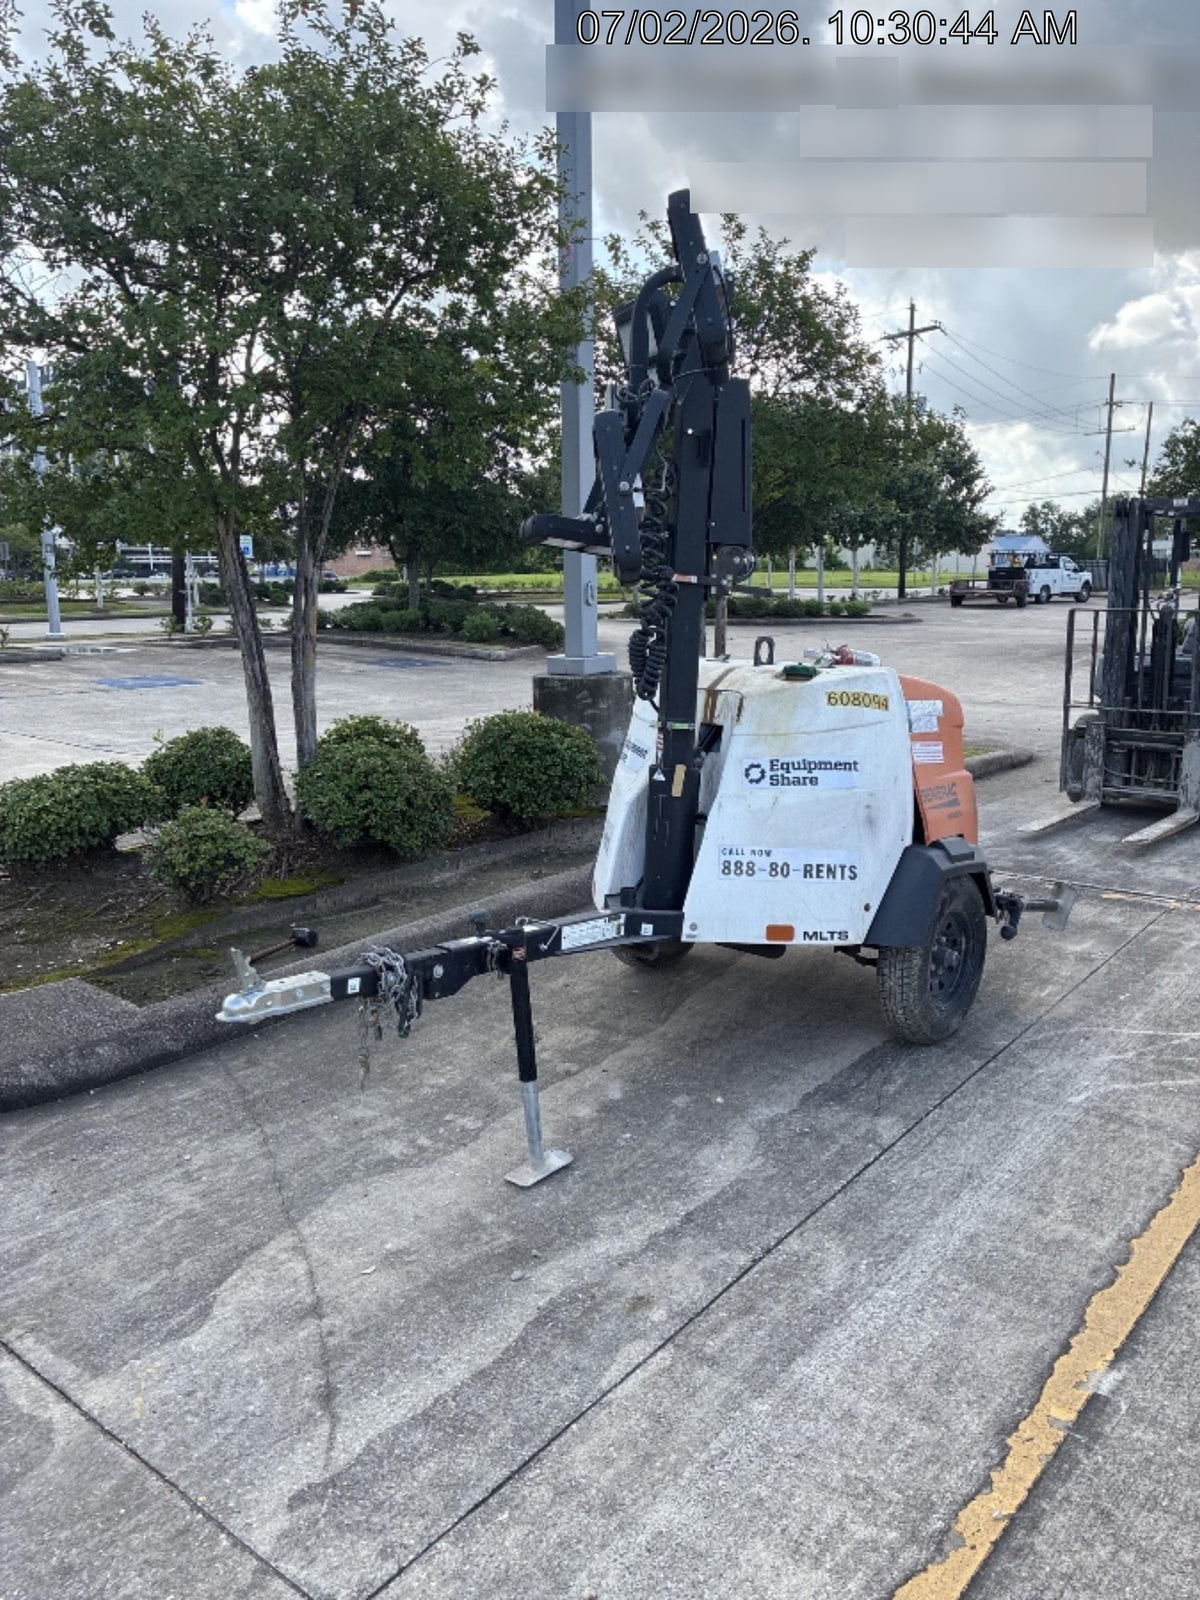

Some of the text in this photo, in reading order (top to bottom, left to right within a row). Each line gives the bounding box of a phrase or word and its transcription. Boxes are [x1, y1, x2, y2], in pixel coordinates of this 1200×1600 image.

[826, 691, 889, 711] 608094
[769, 758, 859, 773] Equipment
[769, 774, 818, 786] Share
[721, 847, 745, 856] CALL
[803, 931, 849, 941] MLTS
